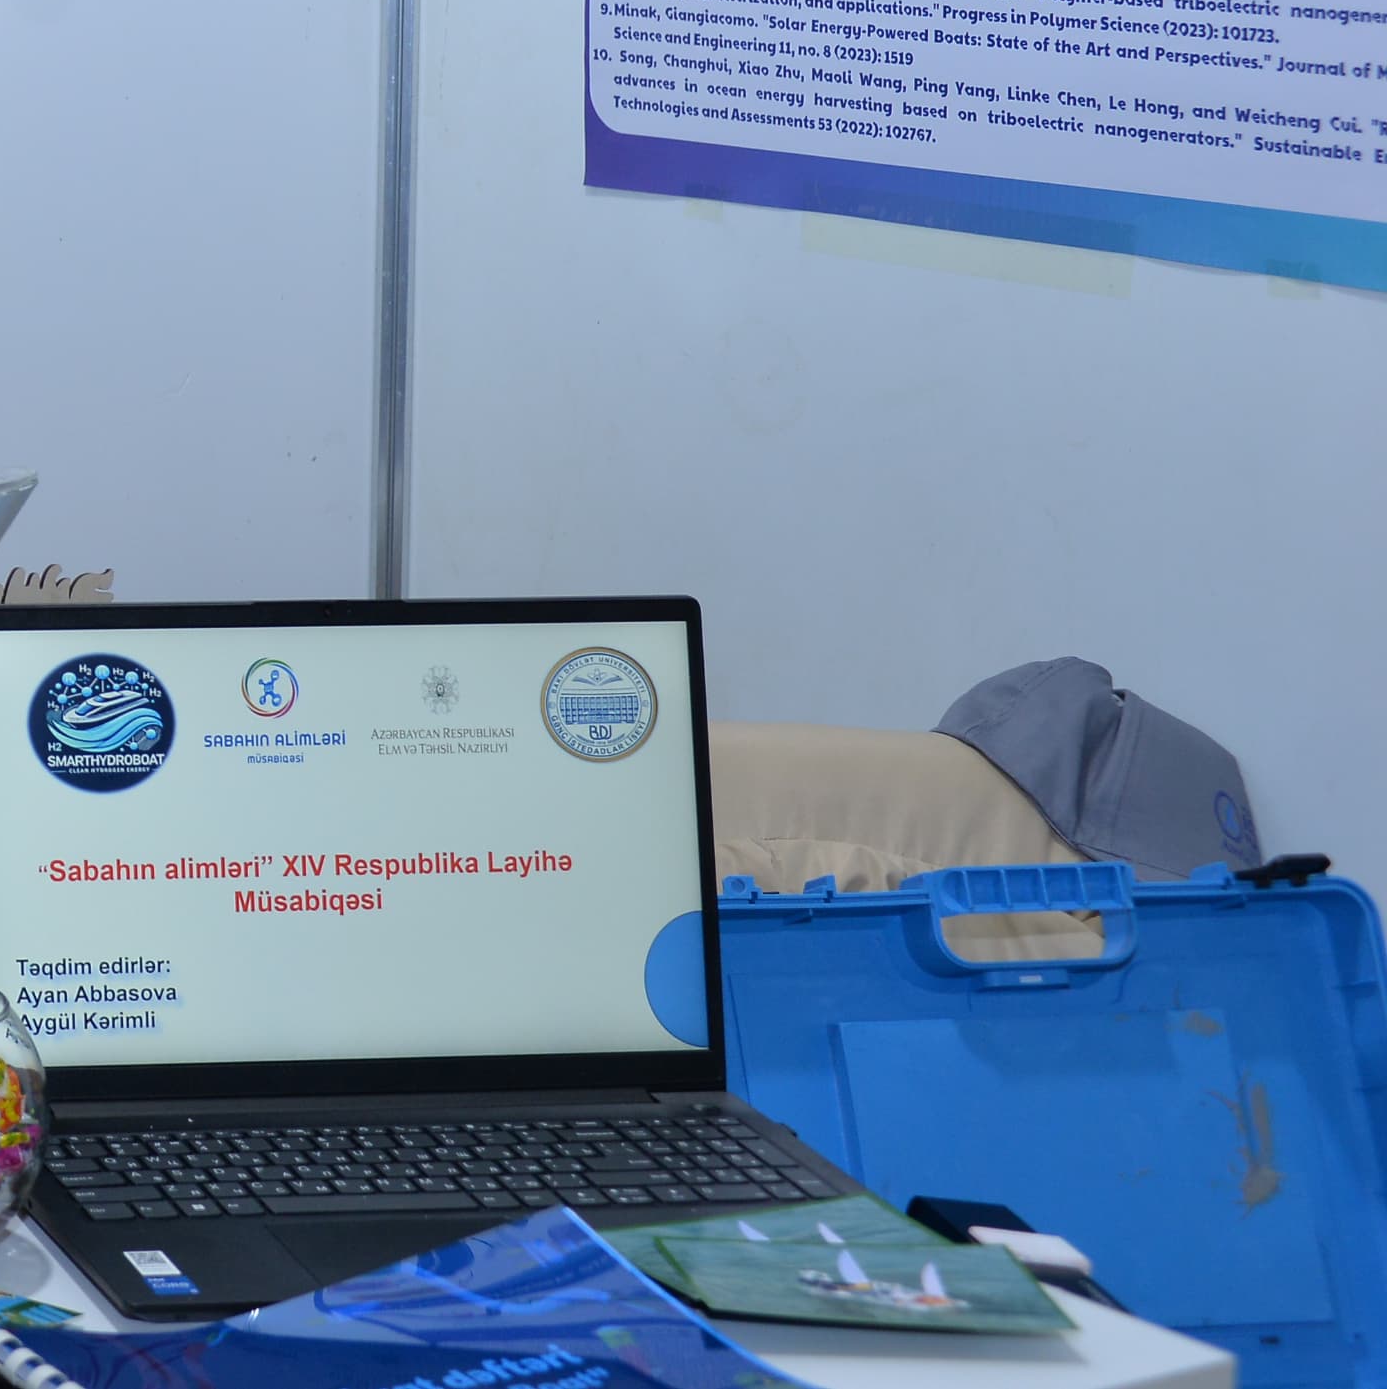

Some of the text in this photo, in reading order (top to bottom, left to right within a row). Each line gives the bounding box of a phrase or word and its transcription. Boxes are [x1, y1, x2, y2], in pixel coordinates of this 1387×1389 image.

[614, 96, 935, 142] Technologies and Assessments 53 (2022): 102767.
[204, 730, 345, 747] SABAHIN ALİMLƏRİ
[48, 754, 164, 766] SMARTHYDROBOAT
[39, 850, 571, 881] “Sabahın alimləri” XIV Respublika Layihə
[235, 888, 381, 916] Müsabiqəsi
[16, 957, 169, 980] Təqdim edirlər:
[17, 985, 176, 1008] Ayan Abbasova
[21, 1011, 155, 1035] Aygül Kərimli
